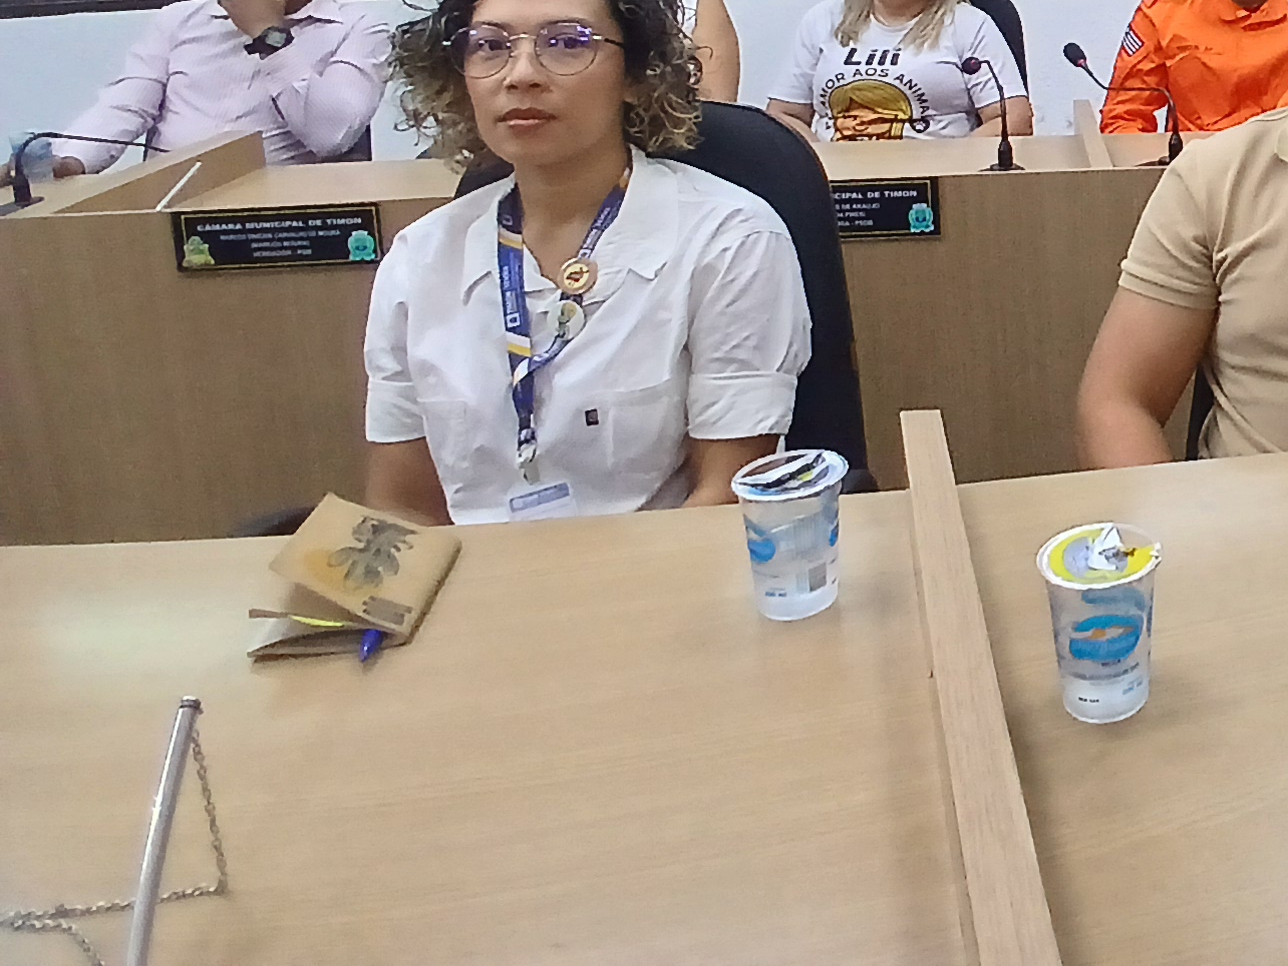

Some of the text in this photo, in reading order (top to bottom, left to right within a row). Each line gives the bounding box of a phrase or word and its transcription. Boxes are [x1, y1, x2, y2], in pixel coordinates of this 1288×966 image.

[843, 47, 902, 66] Lili
[852, 67, 890, 78] AOS
[893, 73, 930, 120] ANIMA
[245, 220, 305, 230] MUNICIPAL
[308, 219, 322, 227] DE
[326, 217, 362, 226] TIMON
